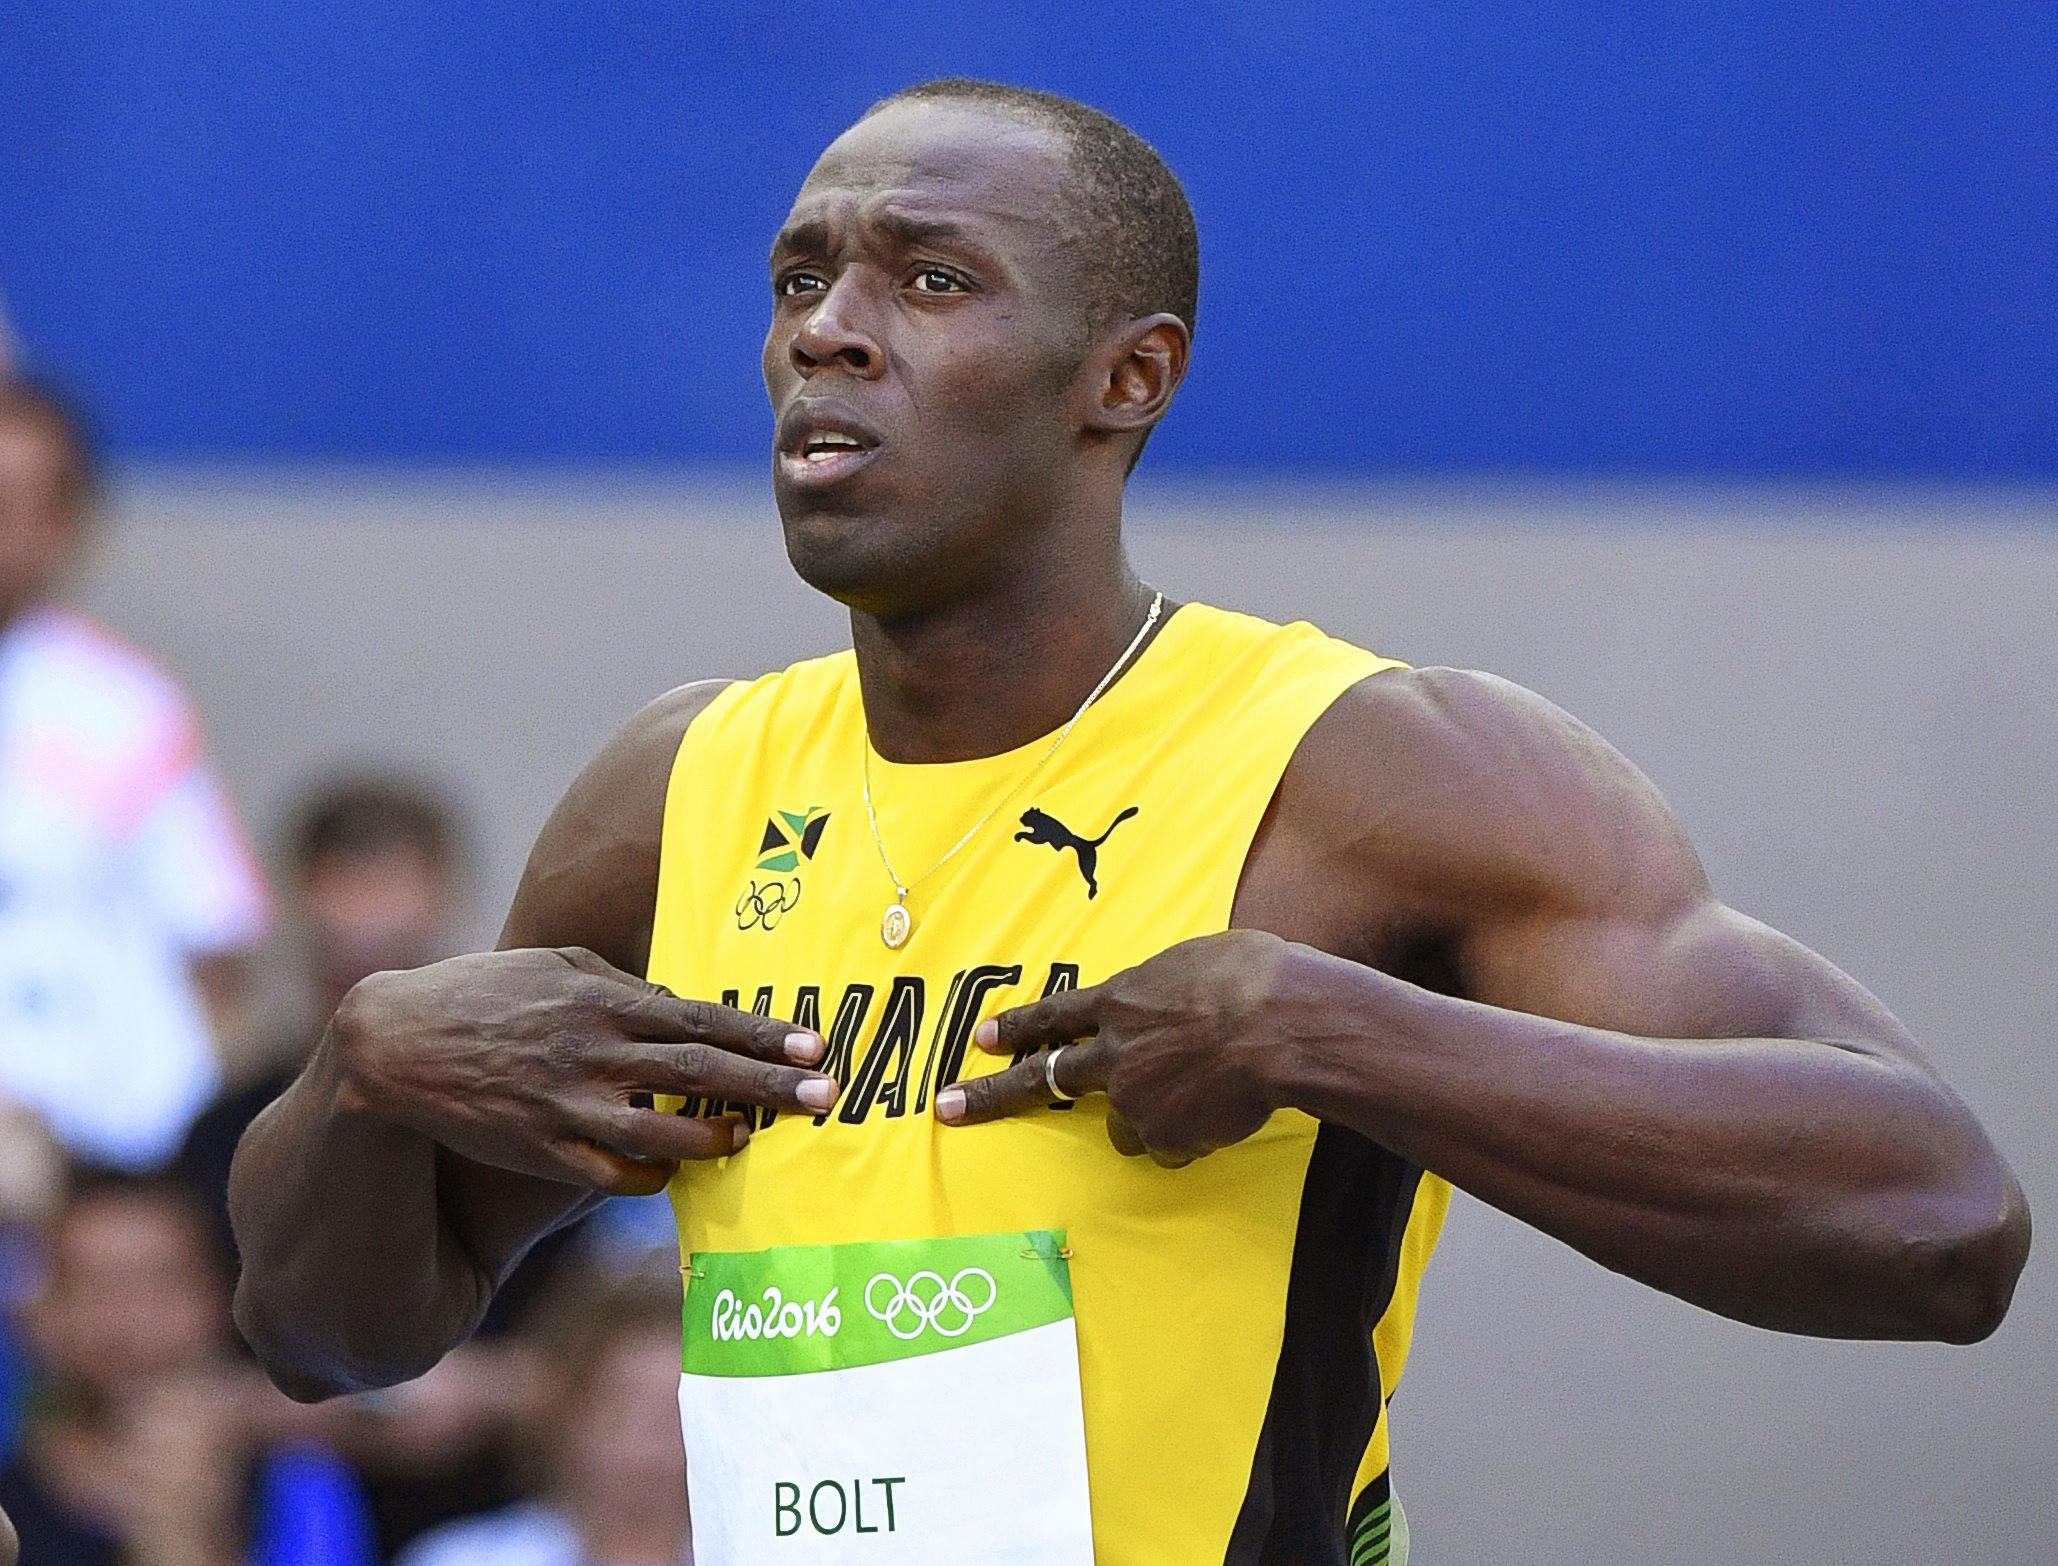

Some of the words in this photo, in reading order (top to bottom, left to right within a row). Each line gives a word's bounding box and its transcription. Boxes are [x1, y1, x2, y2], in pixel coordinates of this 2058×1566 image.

[676, 963, 1079, 1133] MAIC
[711, 1286, 842, 1342] Rio2016
[775, 1476, 906, 1537] BOLT
